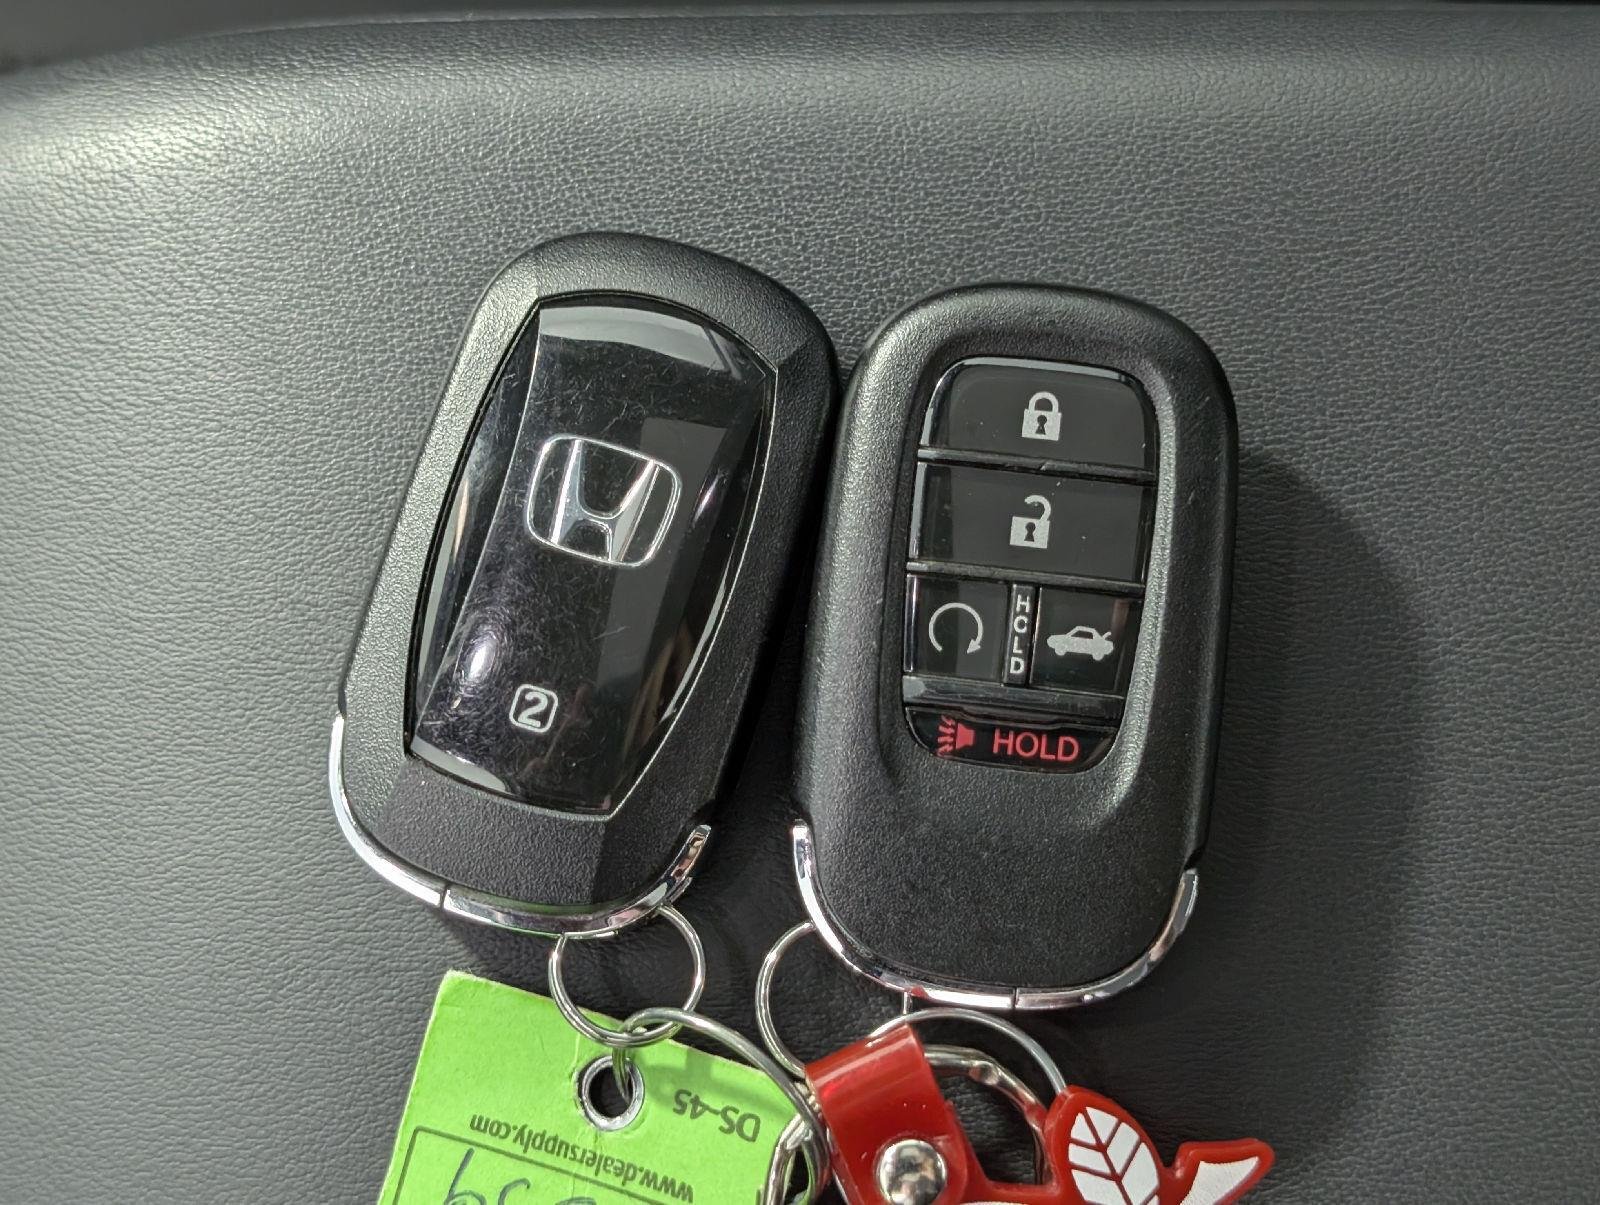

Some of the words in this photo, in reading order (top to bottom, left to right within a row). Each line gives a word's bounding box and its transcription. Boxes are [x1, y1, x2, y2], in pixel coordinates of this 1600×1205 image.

[1009, 594, 1031, 675] HOLD
[517, 691, 549, 728] 2
[992, 727, 1080, 762] HOLD
[672, 1089, 761, 1143] DS-45
[469, 1114, 694, 1204] www.dealersupply.com
